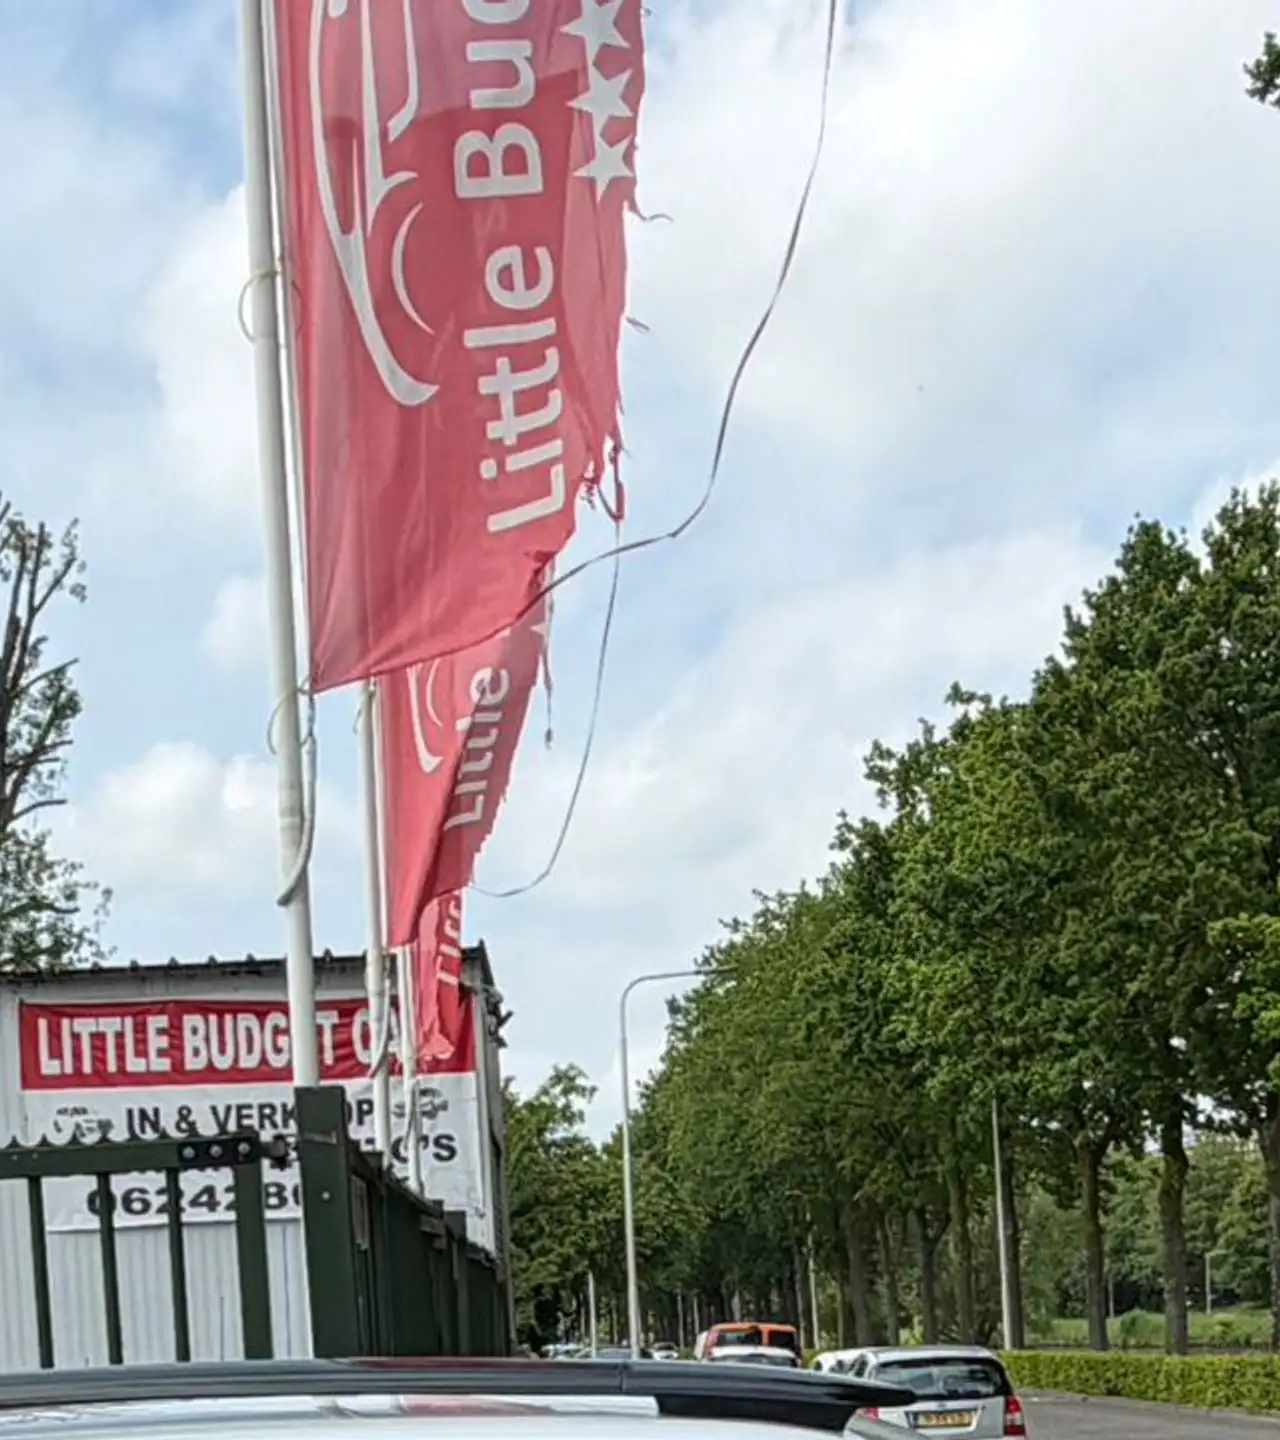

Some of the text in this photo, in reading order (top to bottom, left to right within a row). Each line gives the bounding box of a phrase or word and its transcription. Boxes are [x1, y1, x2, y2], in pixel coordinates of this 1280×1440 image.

[463, 244, 569, 533] Little
[36, 1012, 172, 1076] LITTLE
[183, 1010, 340, 1072] BUDGT
[126, 1106, 161, 1134] IN
[175, 1104, 197, 1134] &
